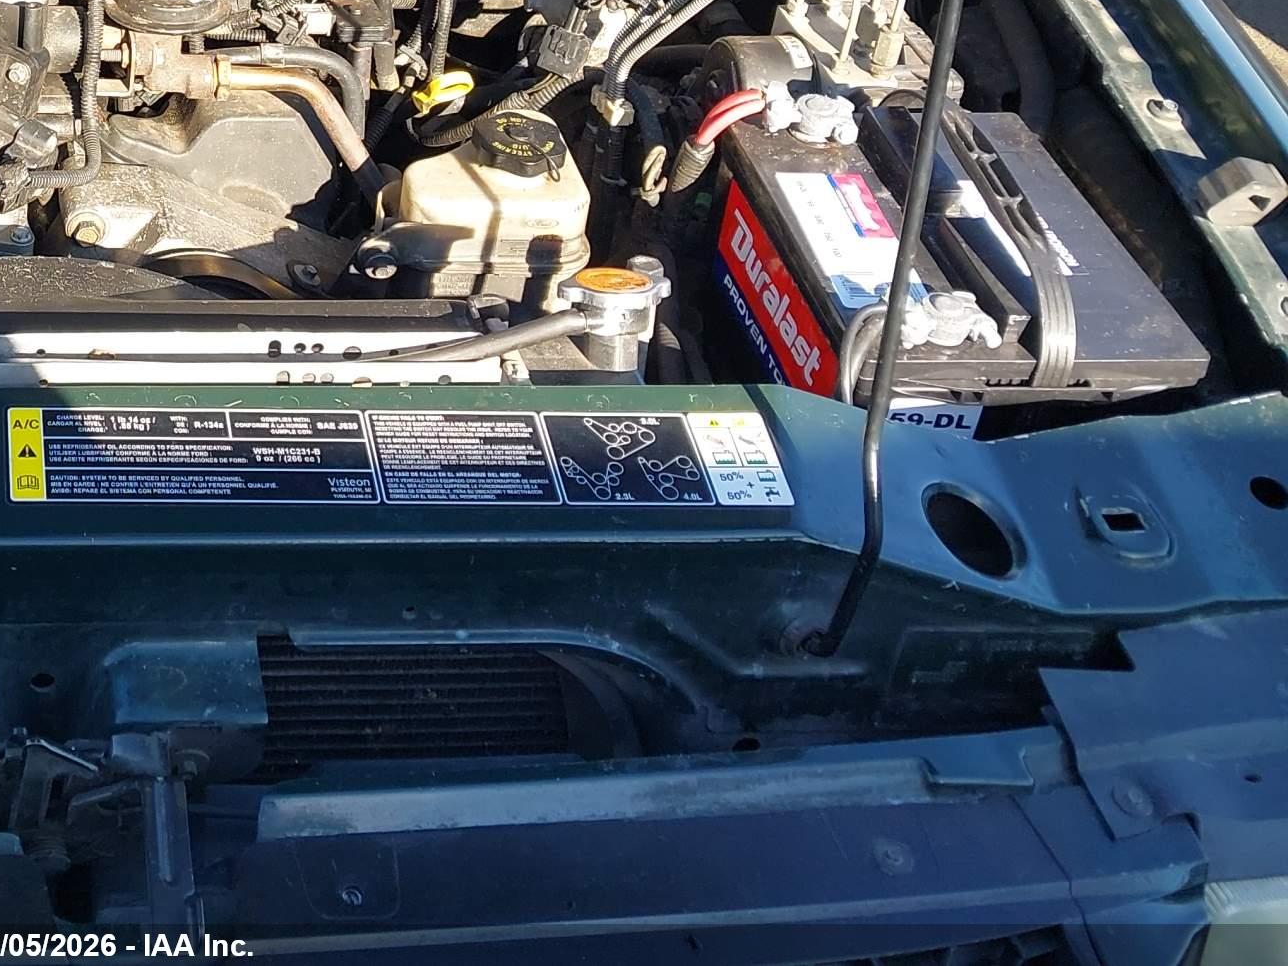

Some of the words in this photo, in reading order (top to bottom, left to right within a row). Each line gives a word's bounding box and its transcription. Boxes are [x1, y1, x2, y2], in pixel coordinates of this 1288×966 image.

[731, 209, 821, 386] Duralast
[723, 274, 768, 352] PROVEN
[13, 420, 40, 430] A/C
[317, 422, 336, 430] SAE
[890, 412, 971, 430] 59-DL
[720, 471, 744, 481] 50%
[328, 477, 371, 486] Visteon
[727, 490, 753, 500] 50%
